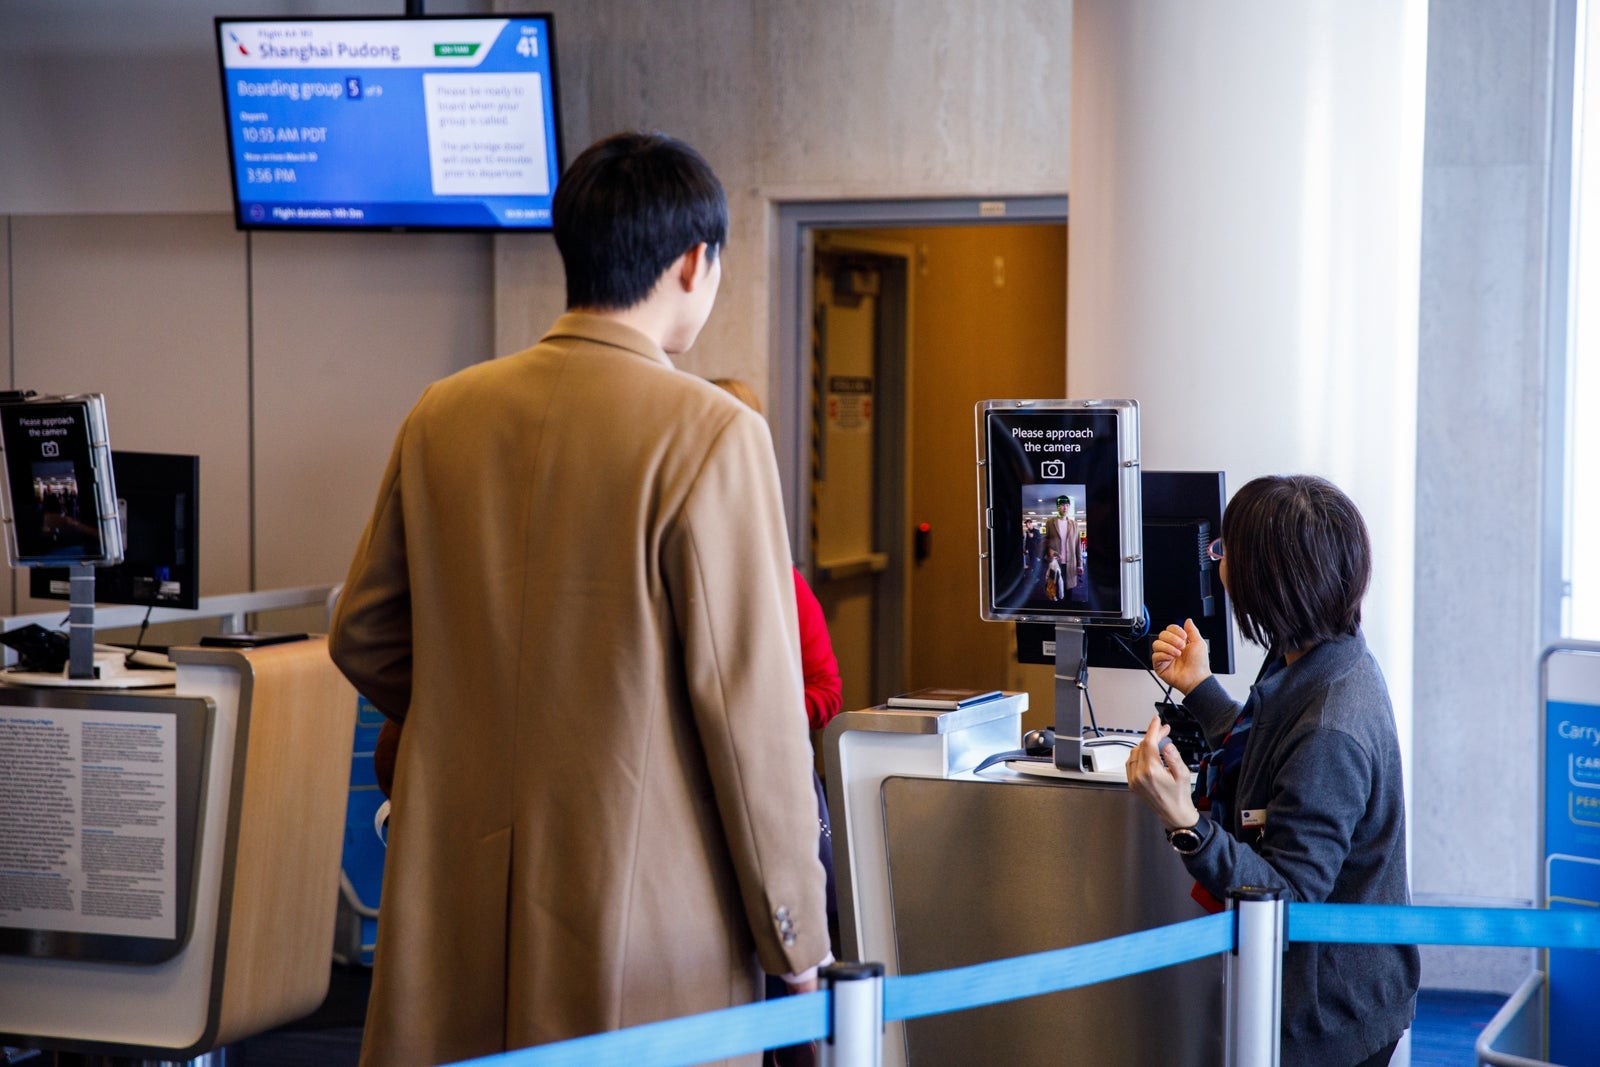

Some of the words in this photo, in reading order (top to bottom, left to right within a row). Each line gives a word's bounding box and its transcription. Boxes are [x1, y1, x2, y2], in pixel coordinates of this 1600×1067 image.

[259, 41, 333, 61] Shanghai
[338, 41, 401, 61] Pudong
[516, 36, 539, 57] 41
[237, 79, 300, 100] Boarding
[302, 82, 343, 99] group
[348, 79, 360, 97] 5
[437, 86, 466, 96] Please
[470, 86, 482, 96] be
[485, 86, 511, 98] ready
[513, 87, 525, 96] to
[439, 101, 466, 111] board
[469, 101, 494, 111] when
[497, 103, 520, 112] your
[439, 117, 466, 128] group
[243, 127, 275, 142] 10:55
[276, 127, 300, 142] AM
[302, 127, 328, 142] PDT
[442, 142, 458, 151] The
[474, 141, 502, 153] bridge
[504, 142, 525, 151] door
[443, 156, 458, 165] will
[497, 156, 534, 165] minutes
[274, 167, 297, 183] PM
[272, 206, 296, 220] Flight
[19, 417, 41, 426] Please
[42, 416, 75, 427] approach
[28, 428, 41, 437] the
[42, 428, 68, 437] camera
[1012, 427, 1044, 438] Please
[1046, 427, 1094, 441] approach
[1024, 441, 1041, 452] the
[1043, 442, 1081, 452] camera
